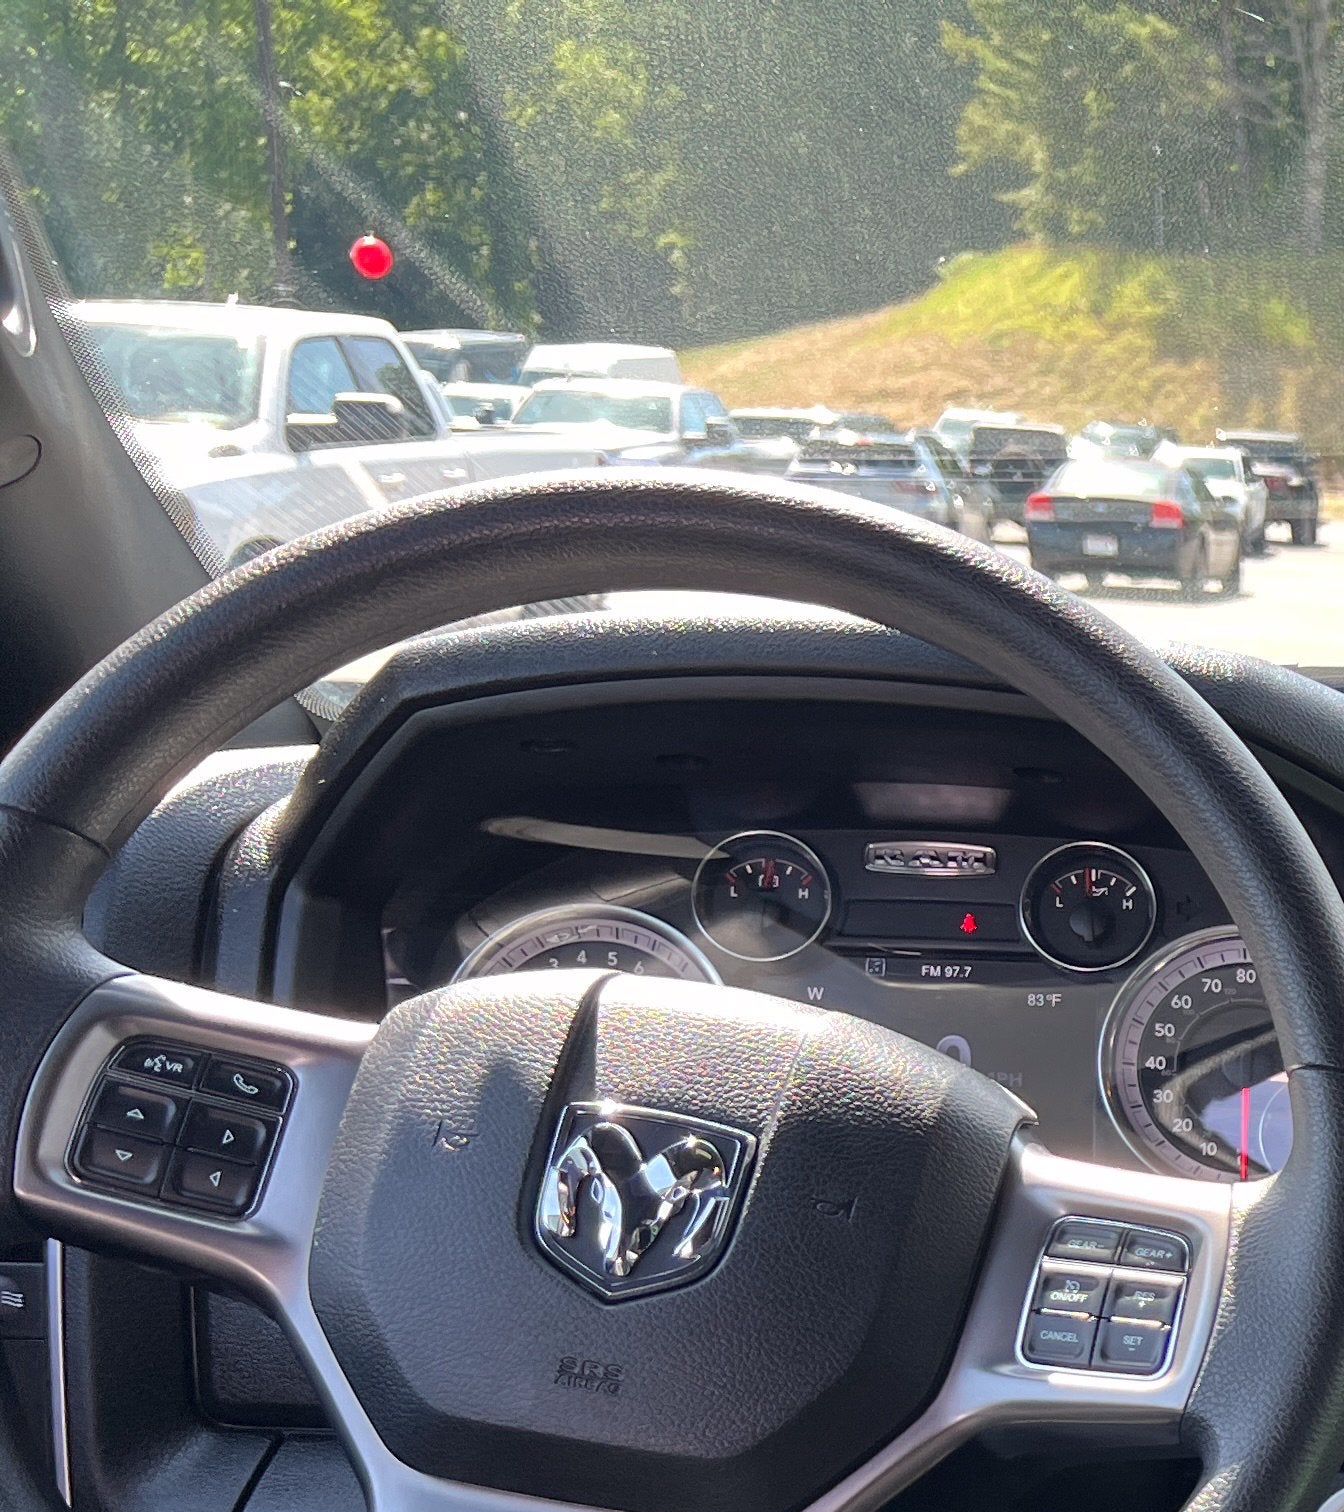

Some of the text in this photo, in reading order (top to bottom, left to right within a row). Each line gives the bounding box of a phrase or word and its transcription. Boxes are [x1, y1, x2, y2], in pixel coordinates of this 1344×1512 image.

[874, 849, 987, 870] RAM
[730, 886, 738, 898] L
[798, 888, 809, 899] H
[1055, 896, 1064, 908] L
[1122, 899, 1133, 910] H
[576, 949, 588, 964] 4
[607, 951, 618, 966] 5
[633, 961, 644, 975] 6
[921, 965, 973, 978] FM 97.7
[1236, 968, 1257, 983] 80
[807, 986, 824, 1000] W
[1201, 978, 1222, 993] 70
[1170, 994, 1192, 1009] 60
[1154, 1022, 1175, 1037] 50
[166, 1061, 183, 1073] VR
[1144, 1055, 1167, 1070] 40
[1152, 1089, 1174, 1104] 30
[1172, 1117, 1193, 1132] 20
[1199, 1141, 1218, 1156] 10
[1040, 1329, 1079, 1343] CANCEL
[1122, 1335, 1144, 1346] SET
